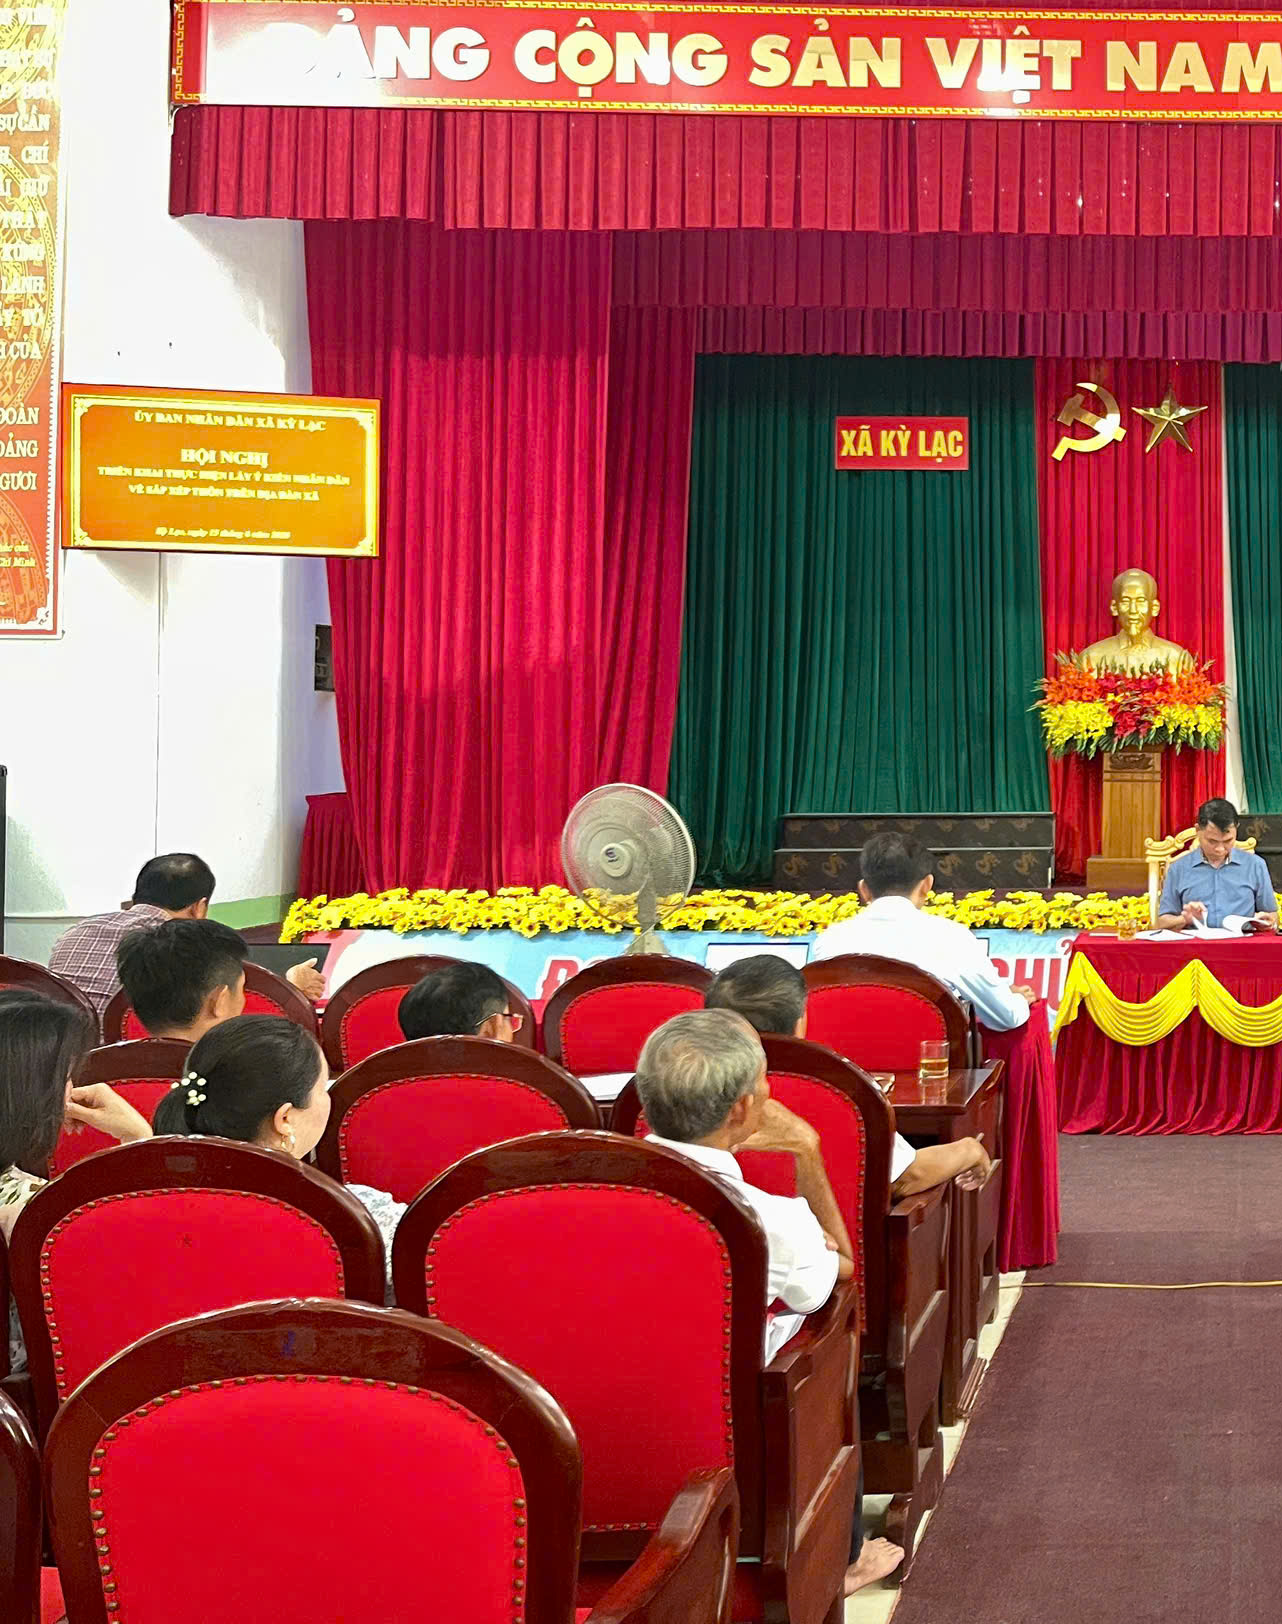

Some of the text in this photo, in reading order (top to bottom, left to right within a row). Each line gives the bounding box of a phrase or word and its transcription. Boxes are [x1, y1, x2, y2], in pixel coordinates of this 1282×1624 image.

[260, 8, 490, 81] ẢNG
[514, 17, 728, 97] CỘNG
[749, 18, 901, 88] SẢN
[926, 26, 1081, 104] VIỆT
[181, 448, 268, 468] HỘI NGHỊ
[841, 425, 963, 463] XÃ KỲ LẠC
